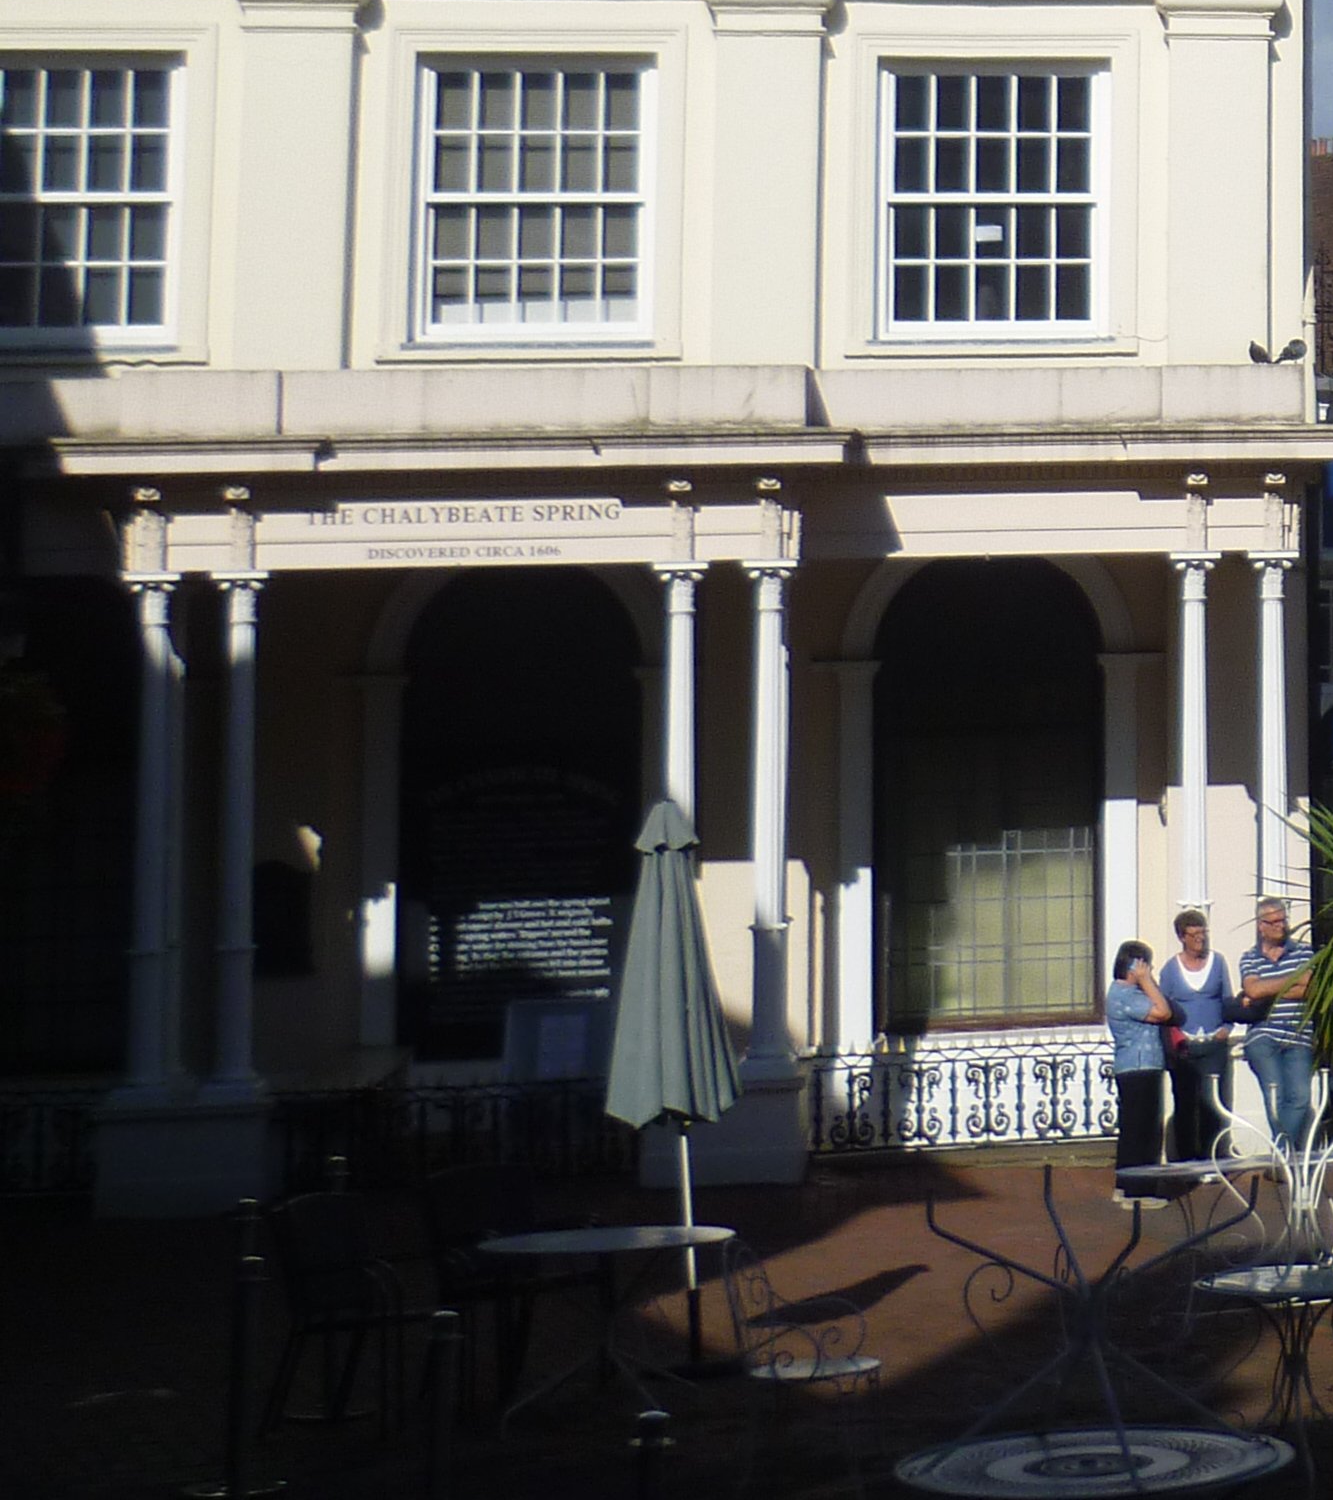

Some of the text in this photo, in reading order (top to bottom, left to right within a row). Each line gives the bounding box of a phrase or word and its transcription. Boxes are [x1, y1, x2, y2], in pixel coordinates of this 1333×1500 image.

[308, 503, 622, 526] THE CHALYBEATE SPRING
[367, 545, 562, 561] DISCOVERED CIRCA 1606
